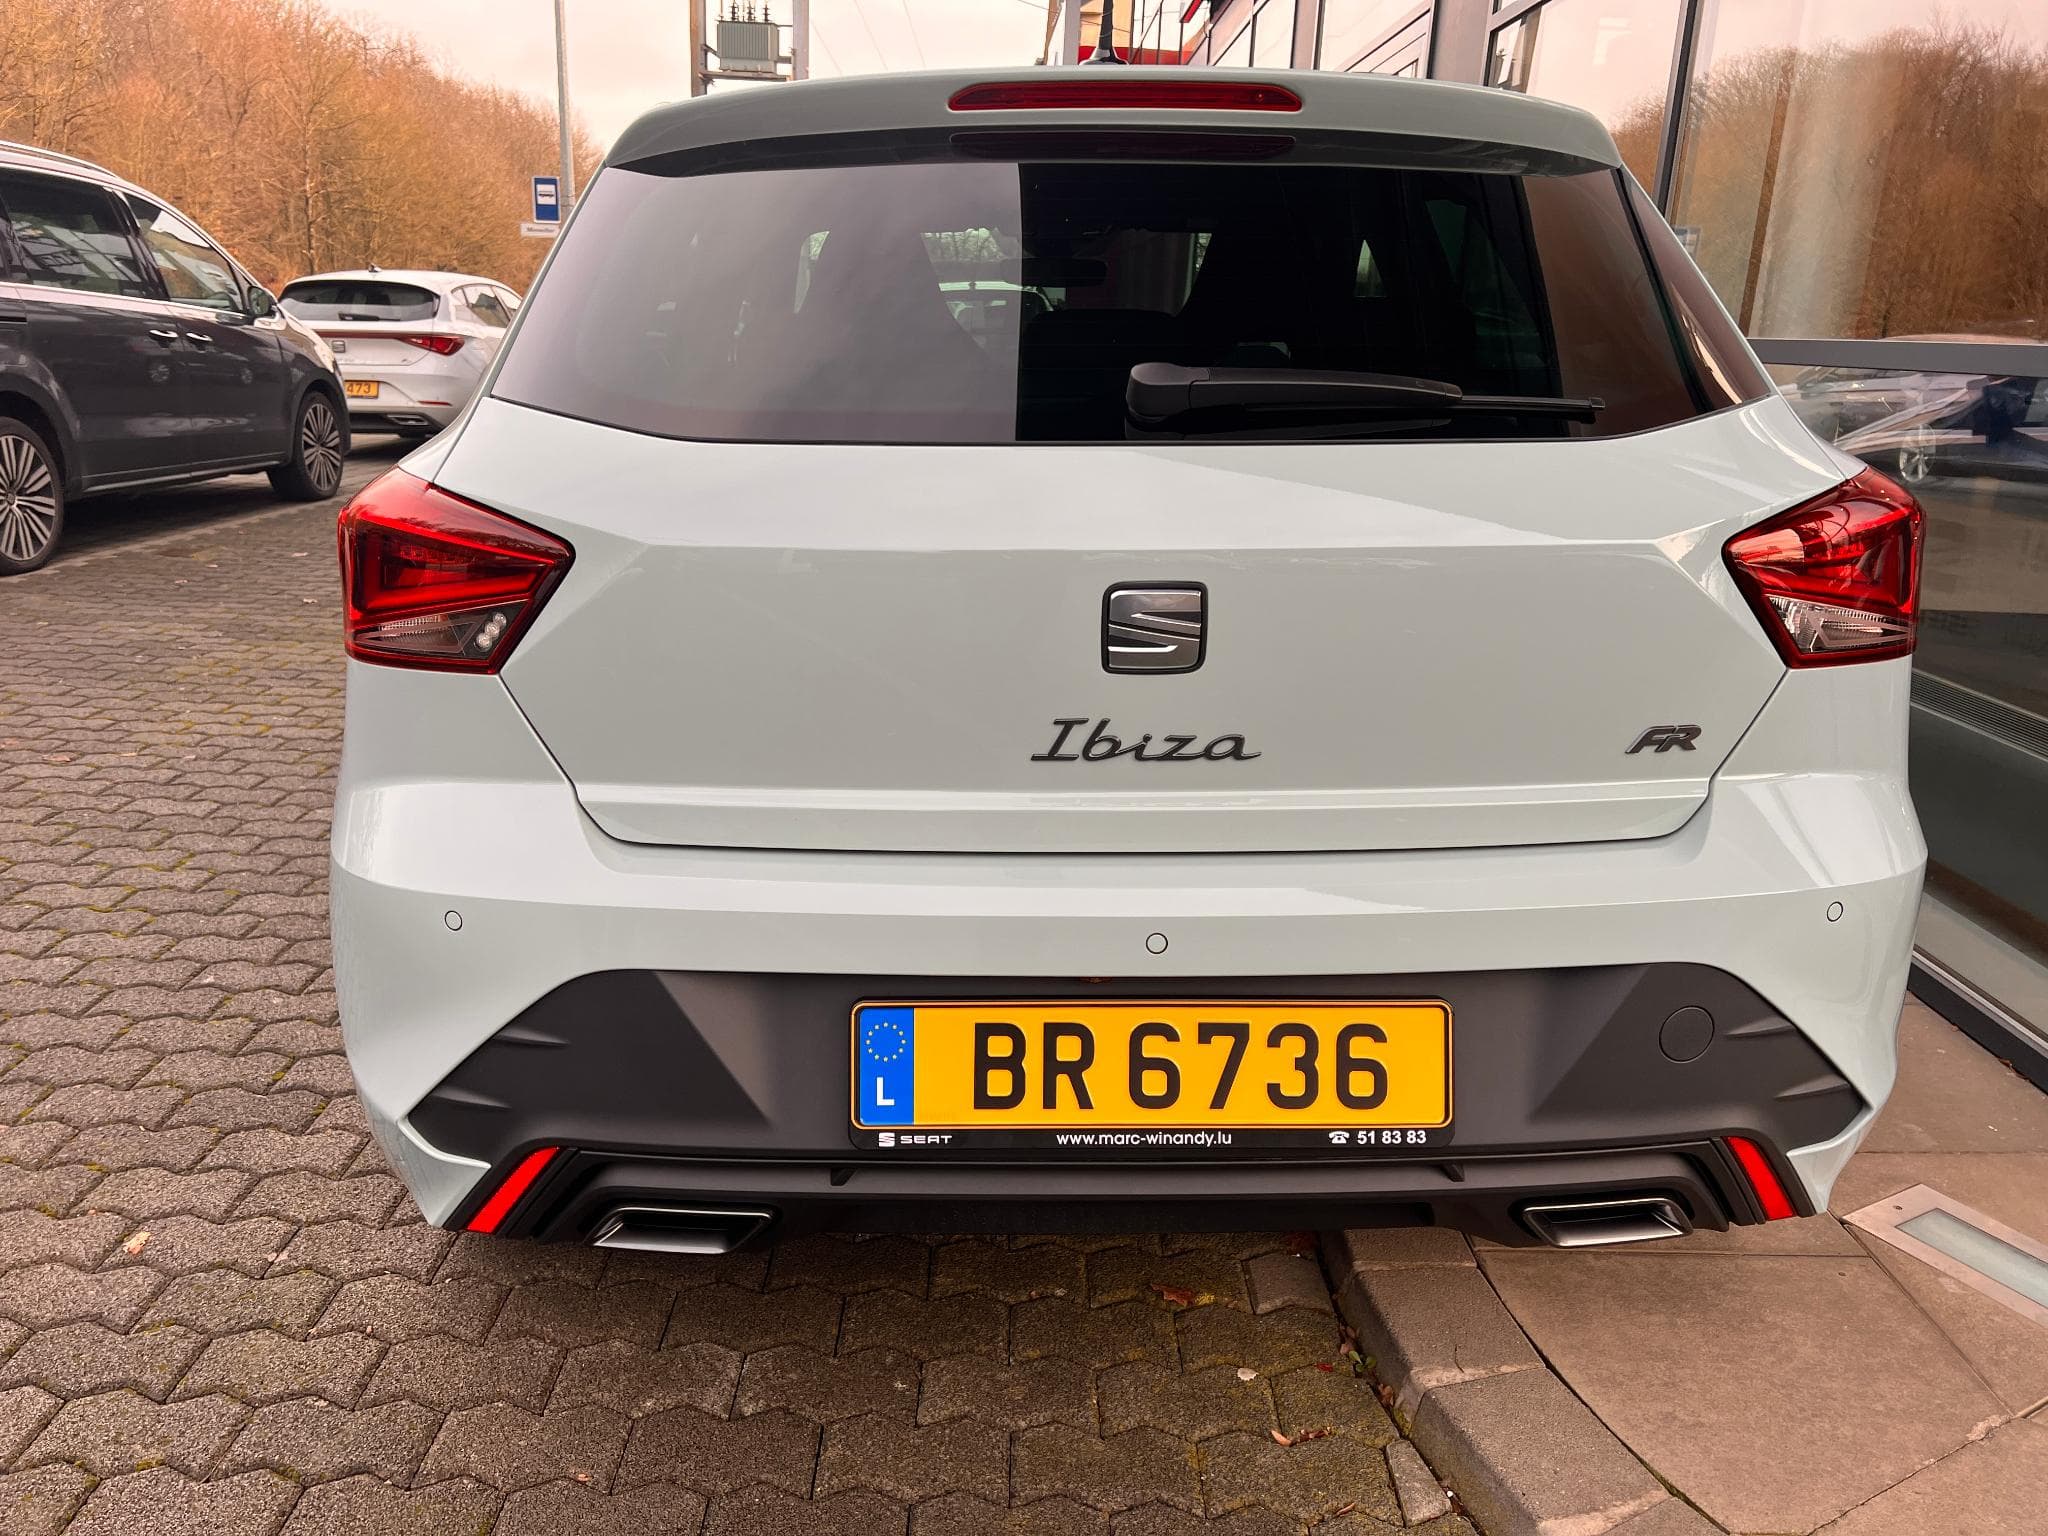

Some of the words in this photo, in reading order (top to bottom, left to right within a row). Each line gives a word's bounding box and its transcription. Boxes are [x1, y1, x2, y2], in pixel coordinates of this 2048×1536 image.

[1030, 717, 1262, 761] Ibiza
[1624, 724, 1702, 754] FR
[973, 1022, 1095, 1110] BR
[1128, 1022, 1389, 1110] 6736
[876, 1077, 895, 1106] L
[900, 1135, 953, 1144] SEAT
[1056, 1131, 1232, 1147] www.marc-winandy.lu
[1357, 1130, 1375, 1144] 51
[1381, 1130, 1401, 1144] 83
[1406, 1130, 1427, 1144] 83
